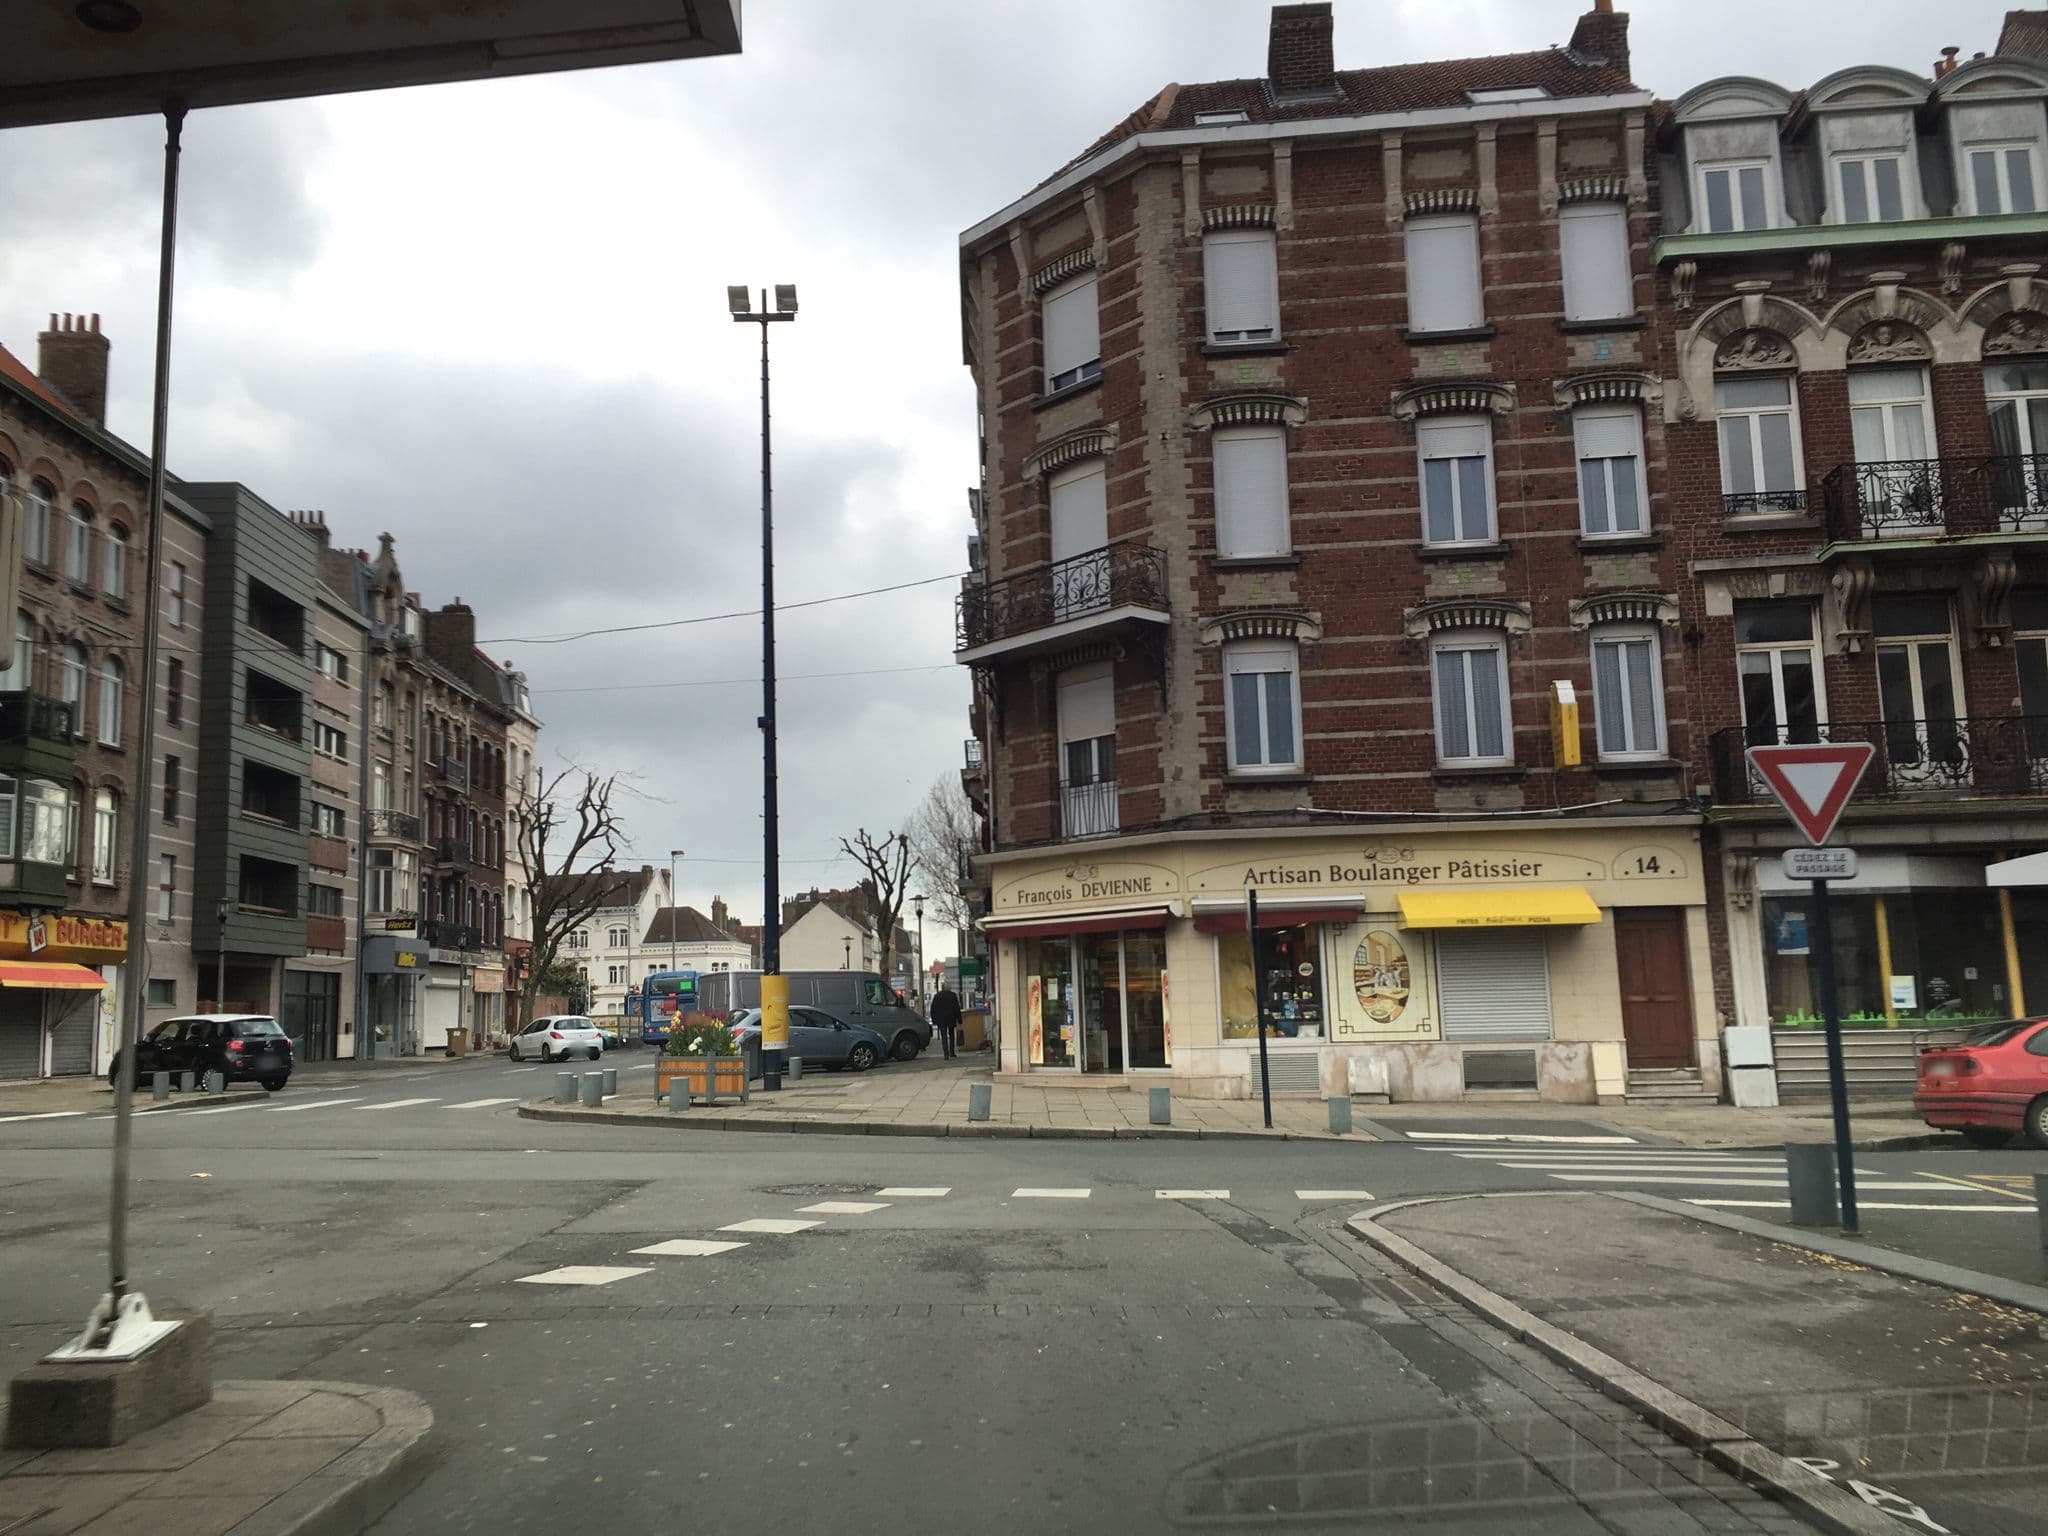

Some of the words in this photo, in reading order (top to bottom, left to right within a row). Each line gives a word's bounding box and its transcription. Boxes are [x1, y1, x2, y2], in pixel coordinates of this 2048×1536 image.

[1243, 865, 1322, 885] Artisan
[1329, 862, 1441, 885] Boulanger
[1448, 858, 1543, 879] Pâtissier
[1636, 856, 1661, 874] 14
[1018, 885, 1072, 904] François
[1082, 877, 1152, 898] DEVIENNE
[56, 919, 122, 948] BURGER
[387, 919, 412, 929] Hertz
